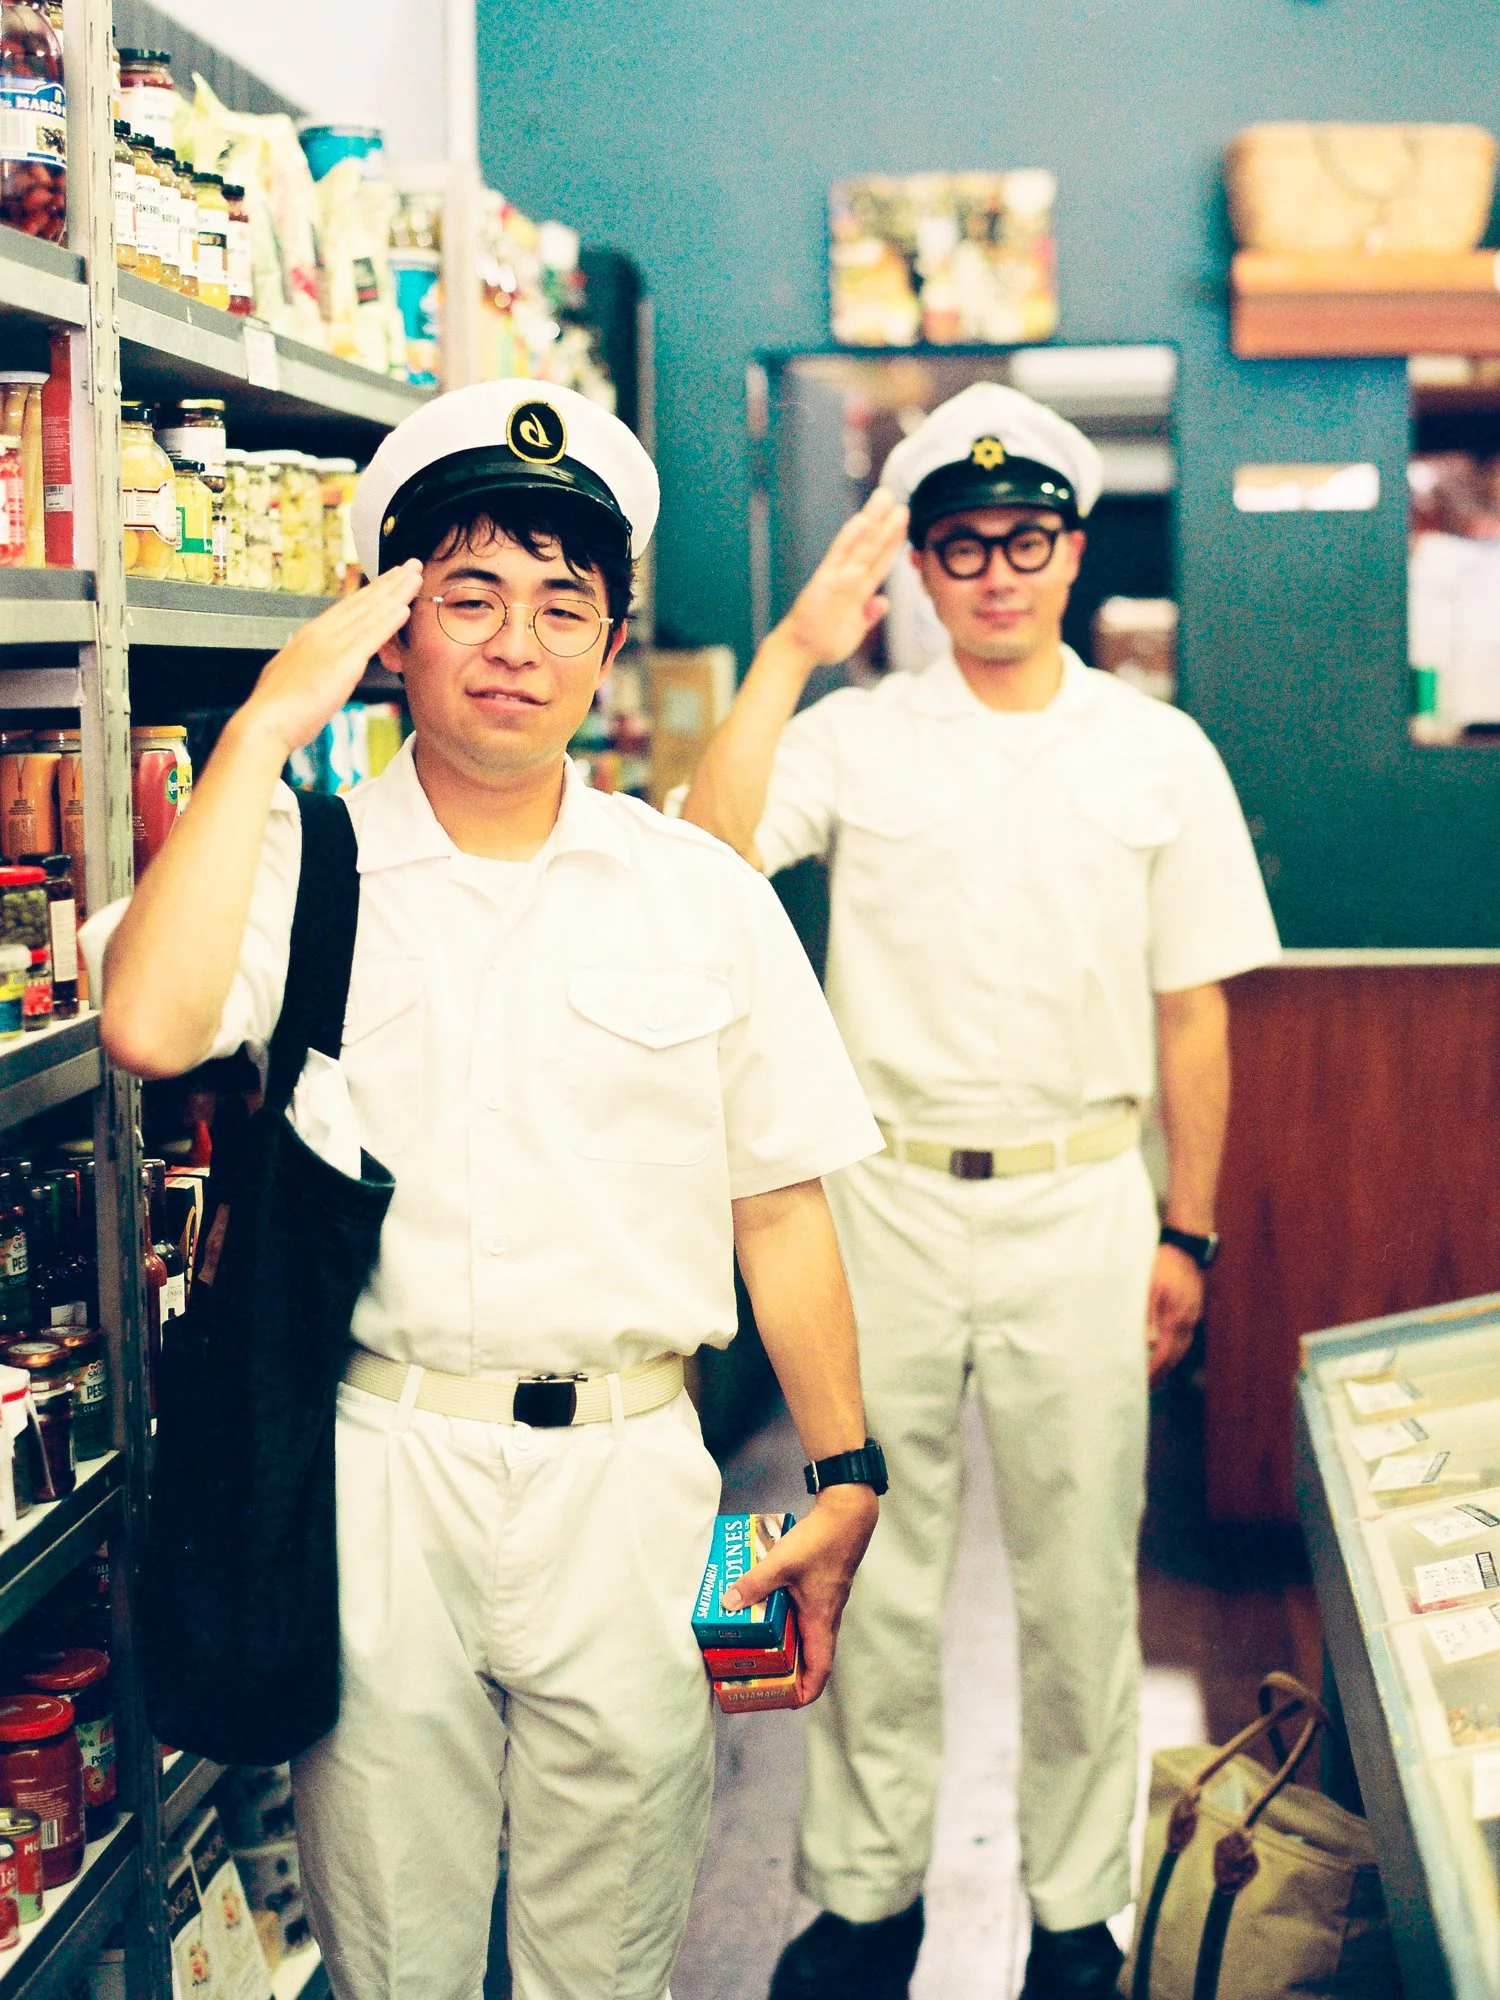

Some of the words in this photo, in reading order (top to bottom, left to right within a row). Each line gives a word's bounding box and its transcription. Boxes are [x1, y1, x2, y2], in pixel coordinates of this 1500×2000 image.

[12, 1255, 27, 1273] PES
[86, 1383, 104, 1400] PES
[724, 1520, 744, 1618] SDINES
[697, 1563, 718, 1619] SANTAMARIA
[24, 1839, 41, 1856] MU
